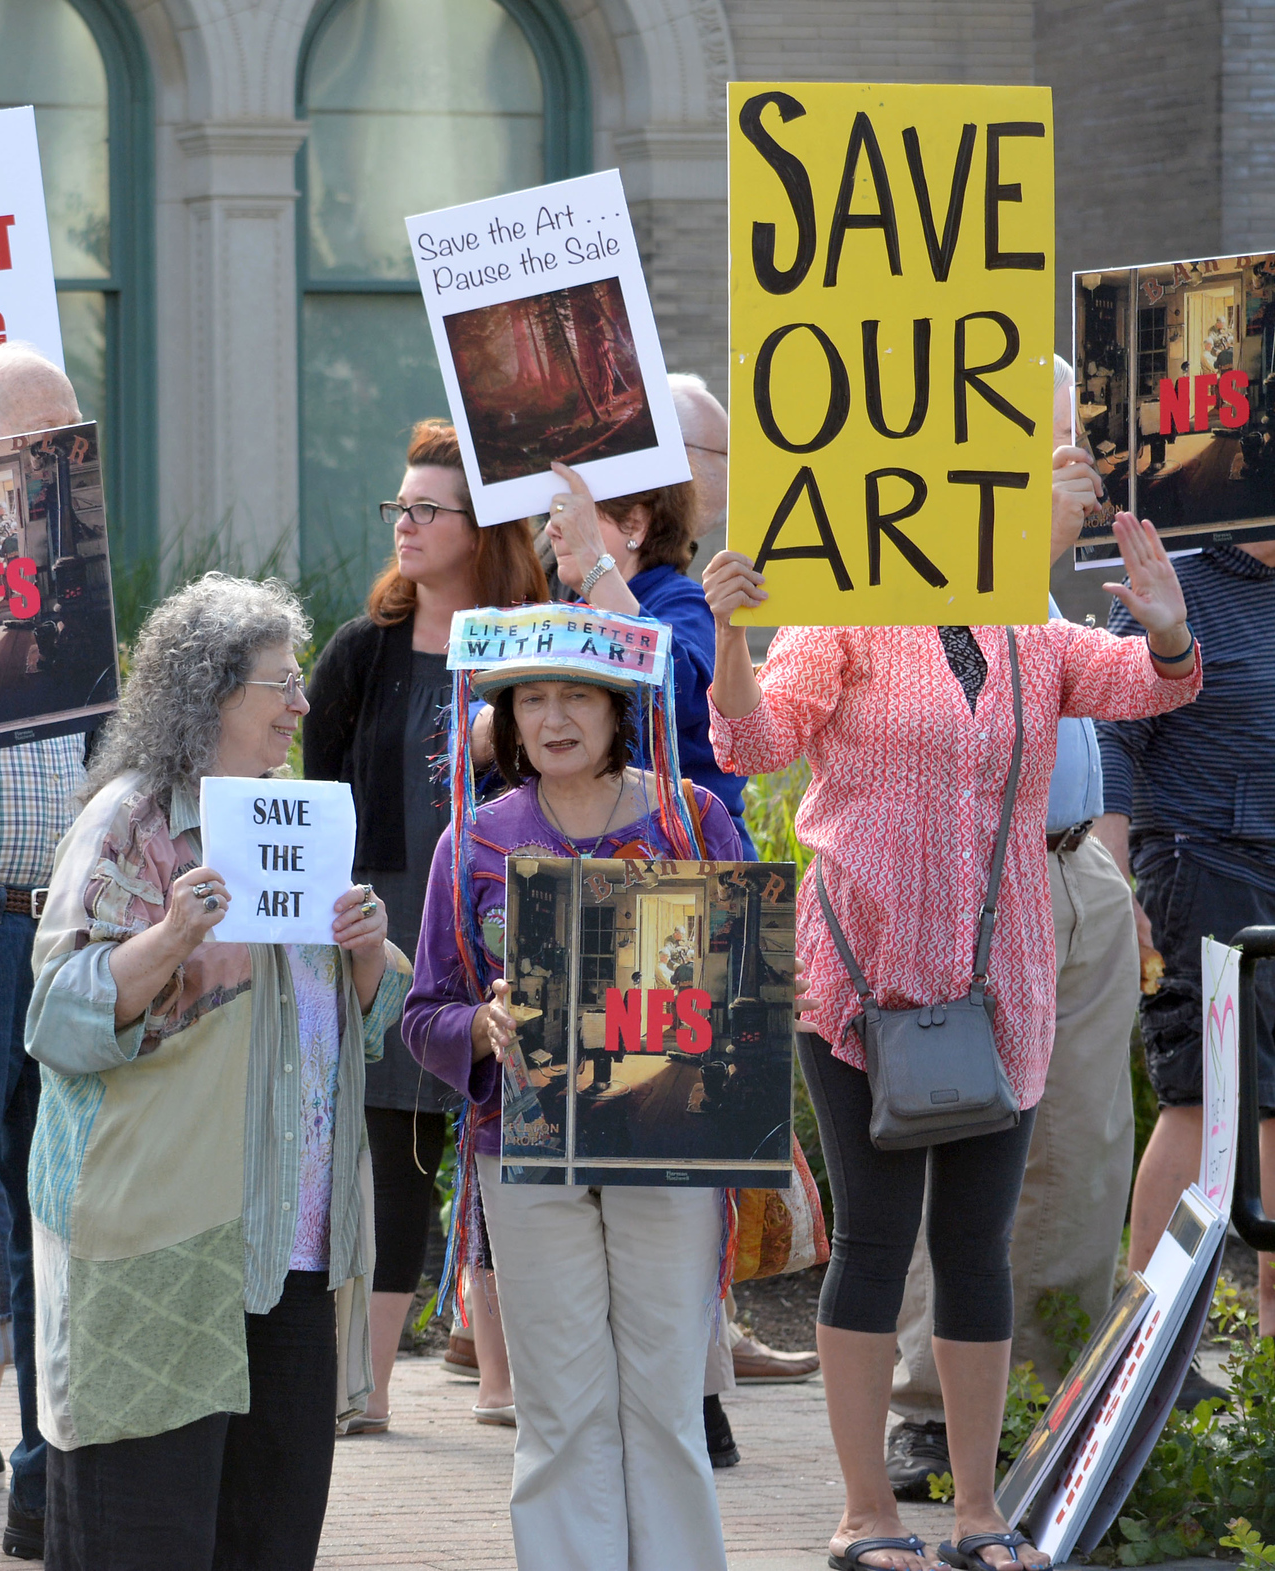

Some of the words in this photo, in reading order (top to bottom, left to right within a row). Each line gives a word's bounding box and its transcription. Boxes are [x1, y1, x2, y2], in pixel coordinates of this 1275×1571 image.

[738, 91, 1045, 296] SAVE
[417, 232, 480, 261] Save
[488, 217, 526, 245] the
[536, 205, 574, 236] Art
[432, 262, 511, 295] Pause
[519, 247, 558, 275] the
[565, 230, 621, 266] Sale
[753, 310, 1037, 454] OUR
[1159, 369, 1250, 436] NFS
[752, 466, 1030, 593] ART
[467, 633, 554, 658] WITH
[580, 636, 650, 667] ART
[469, 623, 518, 637] LIFE
[532, 620, 551, 633] IS
[567, 621, 651, 647] BETTER
[253, 797, 311, 826] SAVE
[257, 843, 305, 872] THE
[256, 890, 304, 918] ART
[605, 987, 712, 1055] NFS
